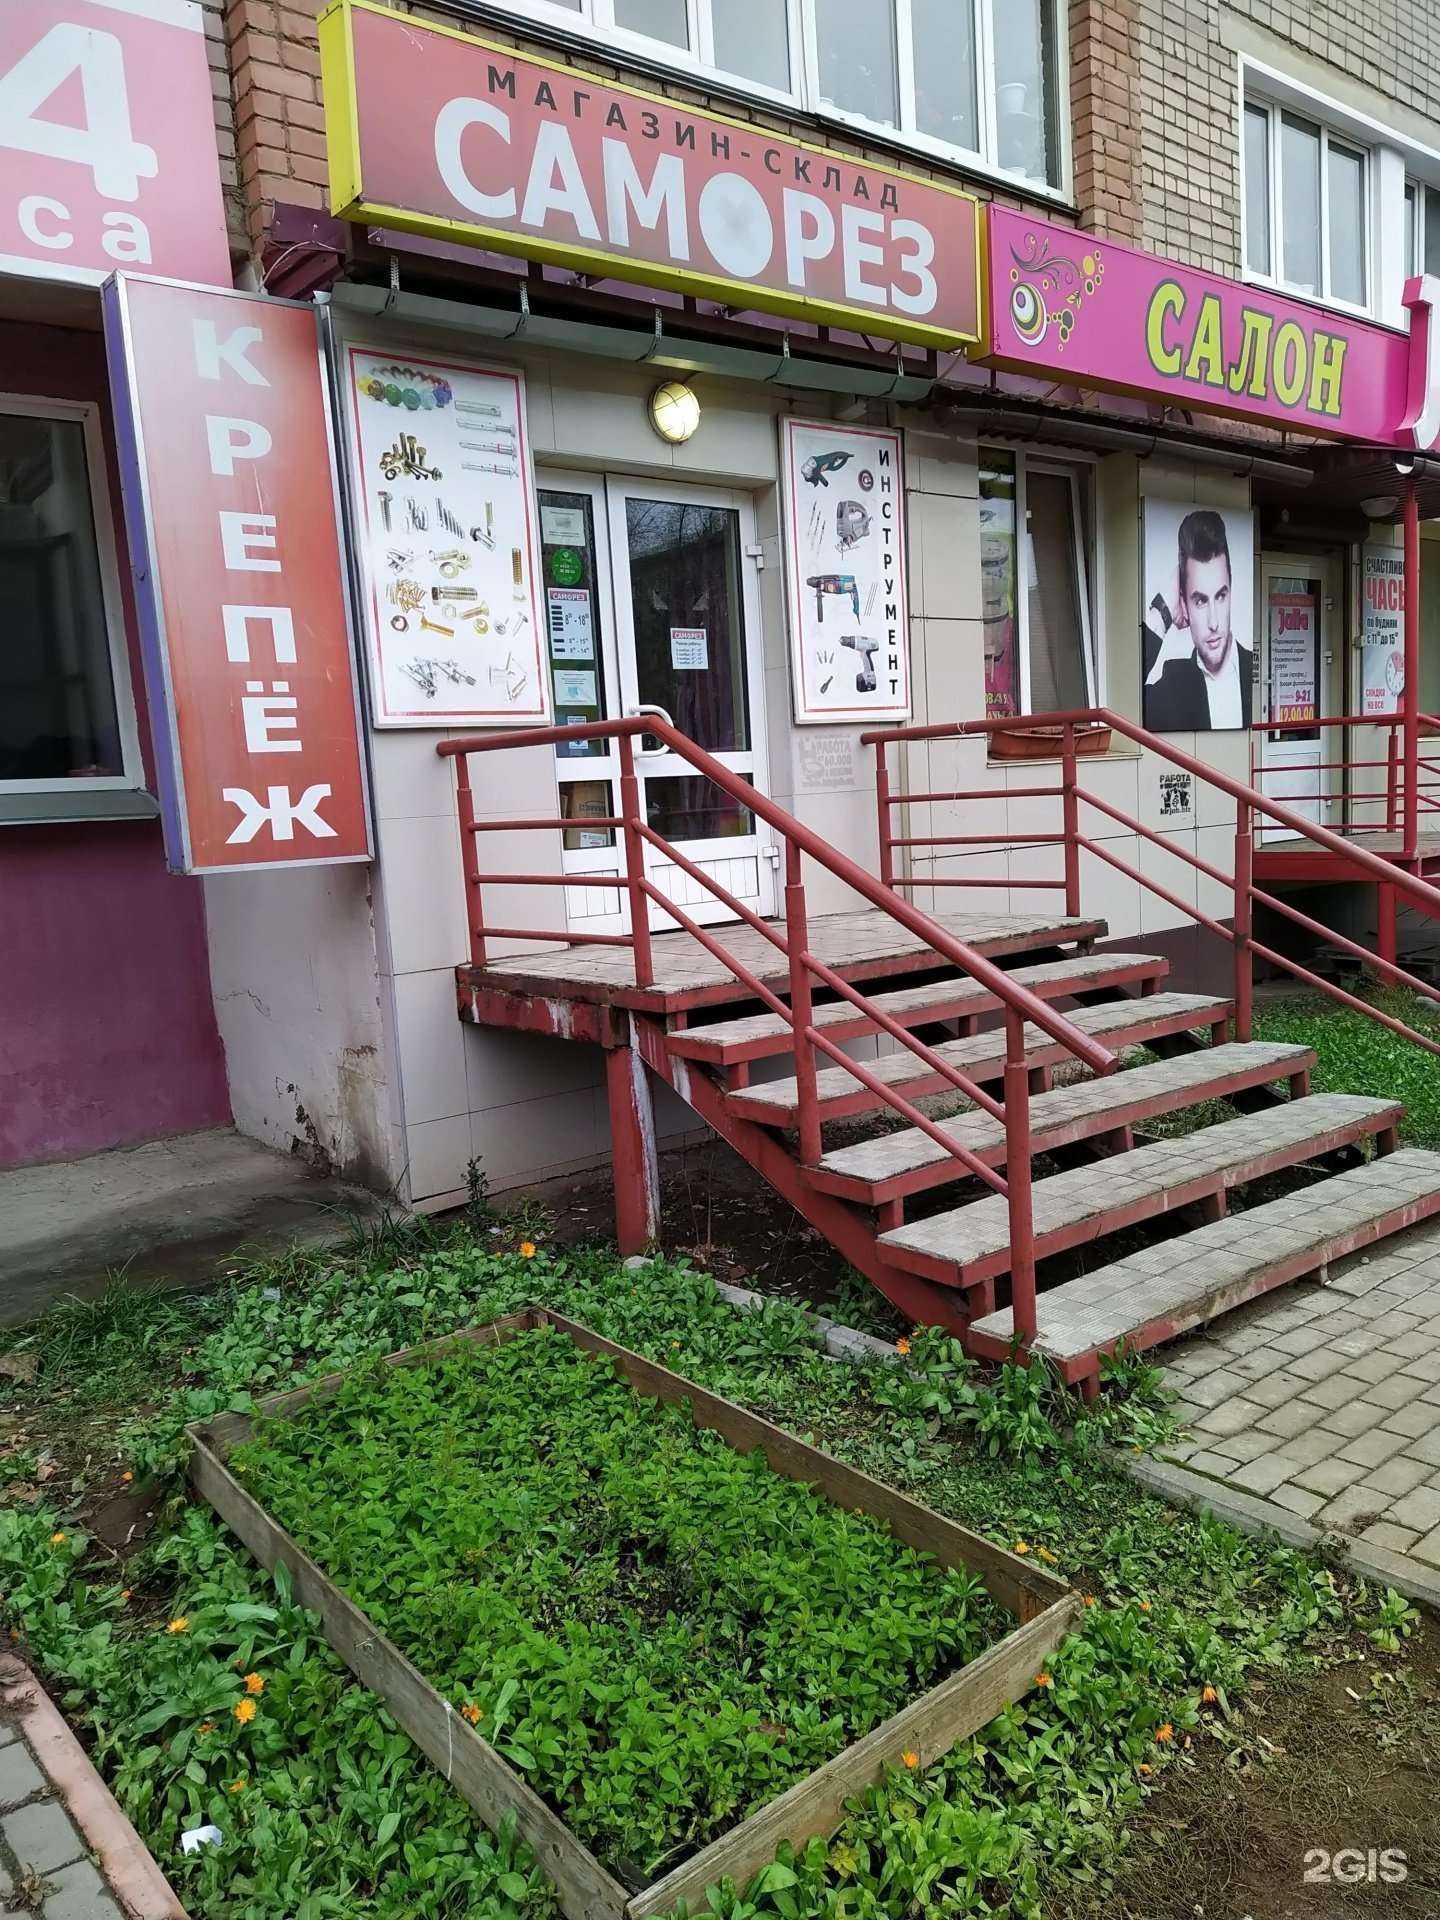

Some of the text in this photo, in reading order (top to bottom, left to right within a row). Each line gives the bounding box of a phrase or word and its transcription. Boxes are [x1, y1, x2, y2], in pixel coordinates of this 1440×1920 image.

[434, 97, 938, 315] САМОРЕЗ
[487, 65, 899, 212] МАГАЗИН-СКЛАД
[1145, 278, 1348, 418] САЛОН
[191, 318, 339, 844] КРЕПЁЖ
[878, 449, 900, 695] ИНСТРУМЕНТ
[1366, 557, 1404, 575] СЧАСТЛИВ
[1159, 774, 1191, 783] РАБОТА
